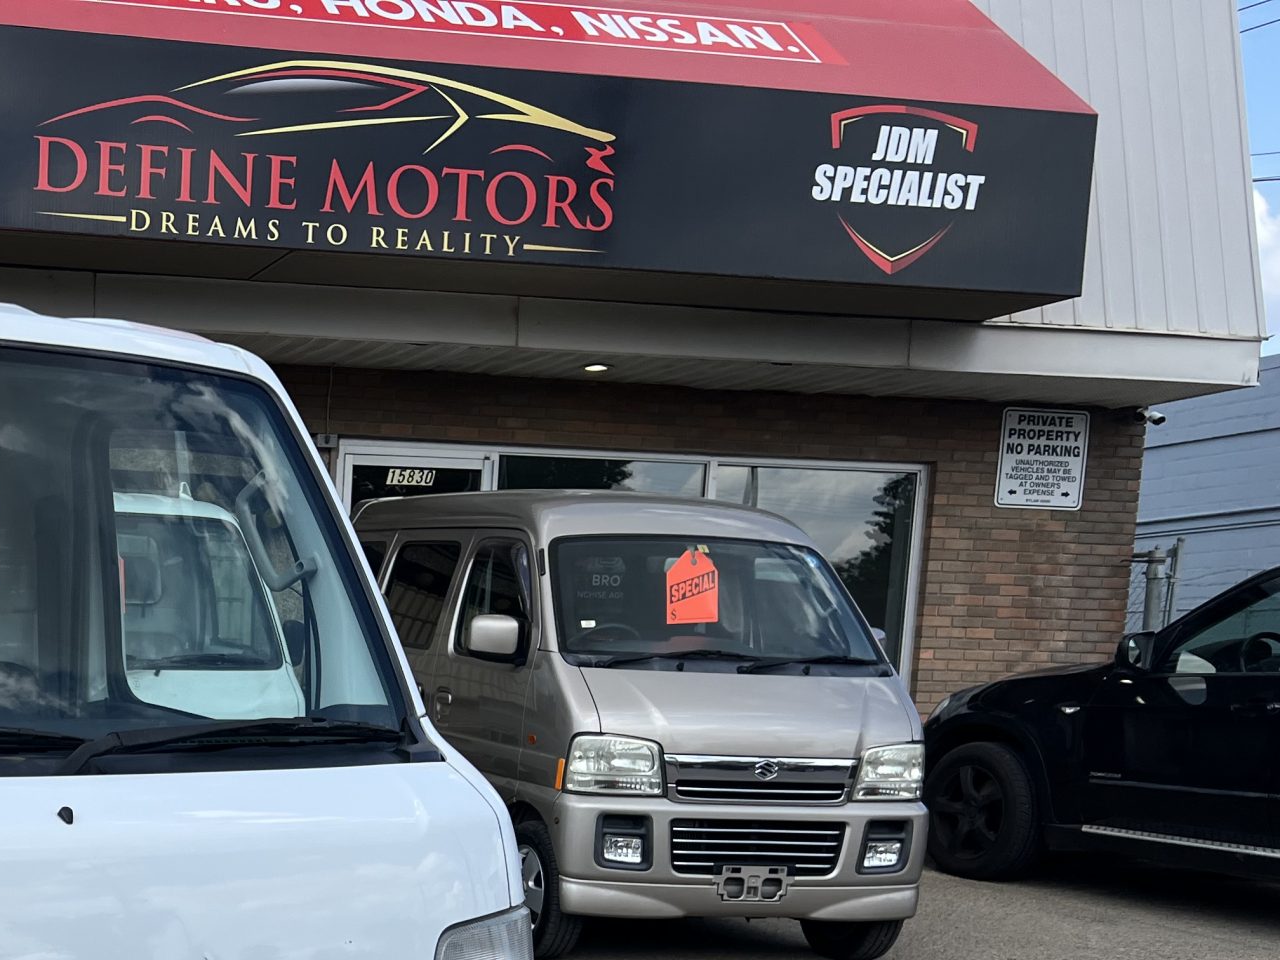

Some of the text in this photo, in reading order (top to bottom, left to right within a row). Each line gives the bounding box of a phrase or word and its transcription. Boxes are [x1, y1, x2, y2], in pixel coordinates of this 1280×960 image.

[570, 11, 800, 53] NISSAN.
[872, 125, 939, 165] JDM
[34, 136, 615, 232] DEFINE MOTORS
[811, 163, 986, 211] SPECIALIST
[129, 209, 523, 257] DREAMS TO REALITY
[1017, 414, 1074, 428] PRIVATE
[1008, 428, 1082, 442] PROPERTY
[1006, 442, 1081, 457] NO PARKING
[1011, 466, 1045, 474] VEHICLES
[1015, 459, 1070, 467] UNAUTHORIZED
[390, 470, 434, 484] 15830
[1005, 473, 1033, 481] TAGGED
[1052, 475, 1077, 483] TOWED
[671, 571, 715, 602] SPECIAL
